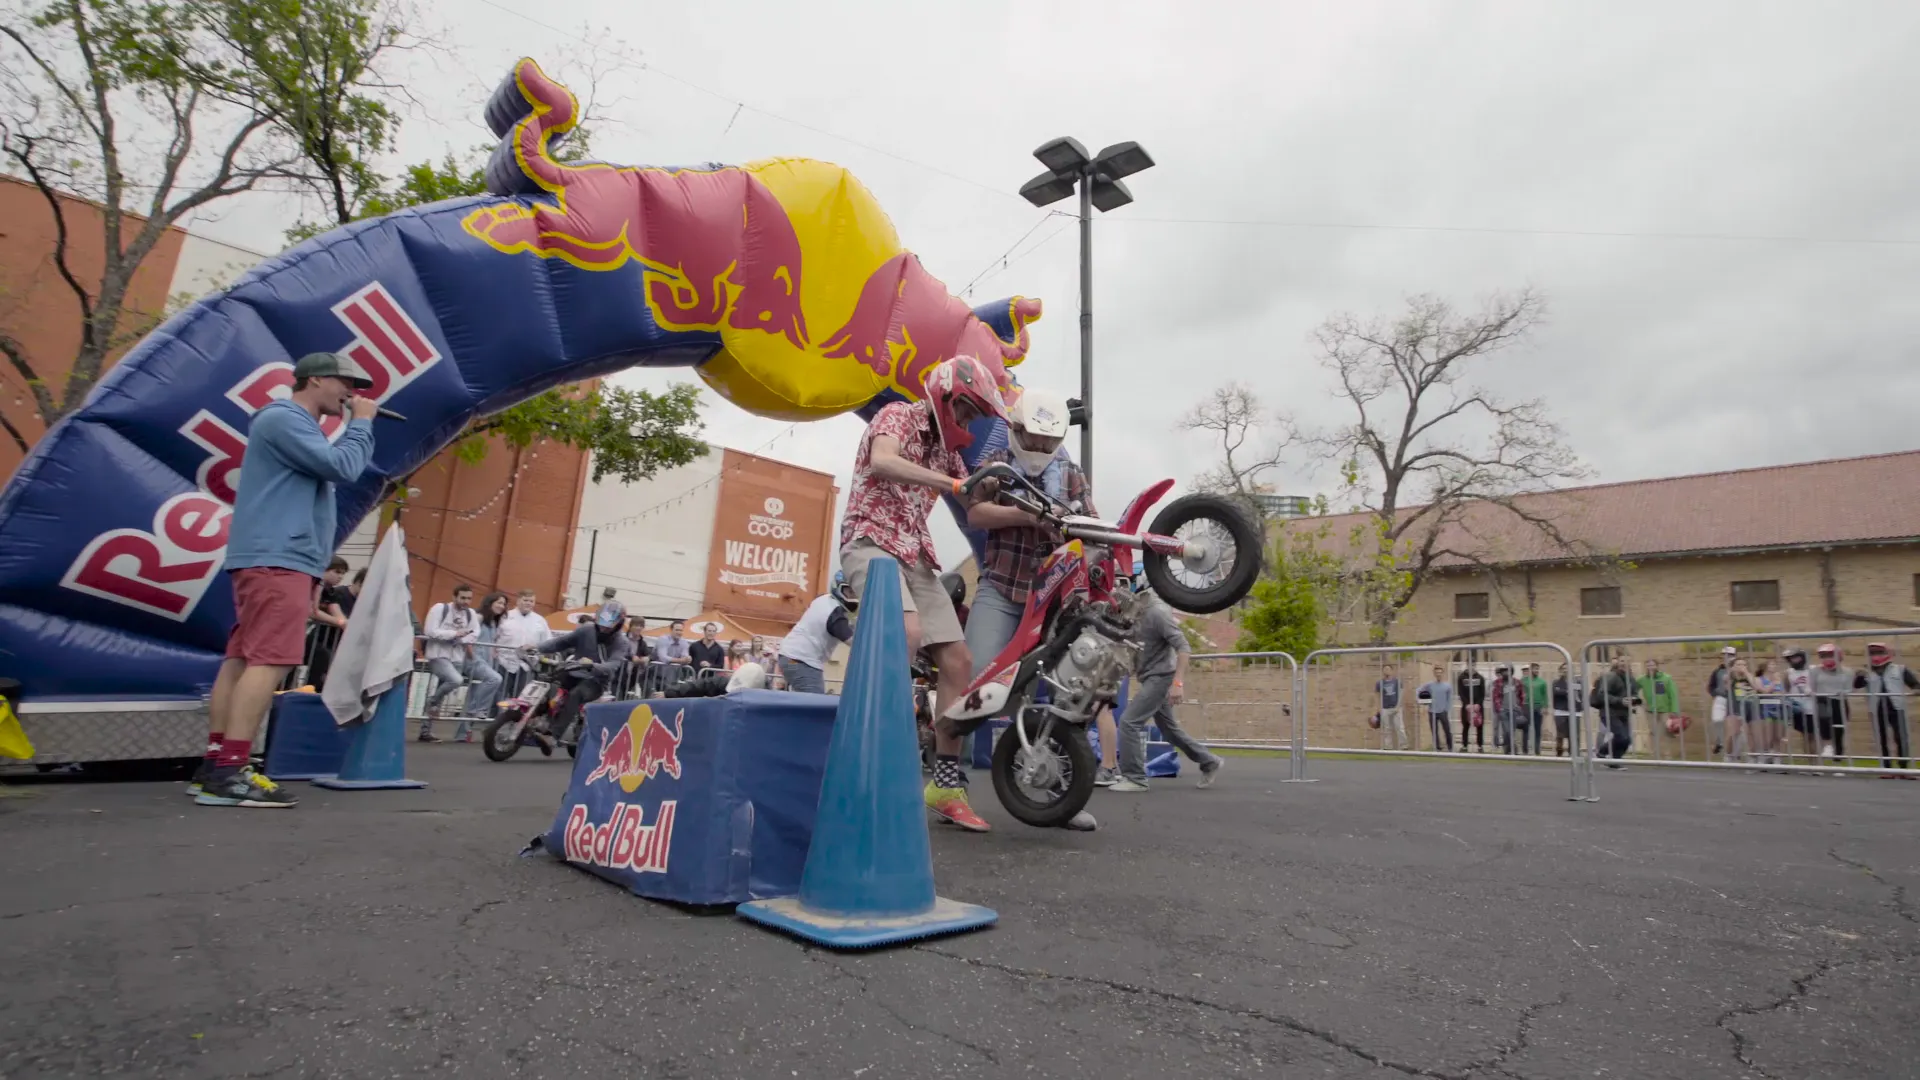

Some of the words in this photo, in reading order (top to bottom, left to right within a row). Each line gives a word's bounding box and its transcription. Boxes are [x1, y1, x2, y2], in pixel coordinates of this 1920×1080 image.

[748, 520, 793, 540] CO-OP
[725, 539, 809, 576] WELCOME
[563, 801, 627, 868] Red
[609, 800, 678, 874] Bull
